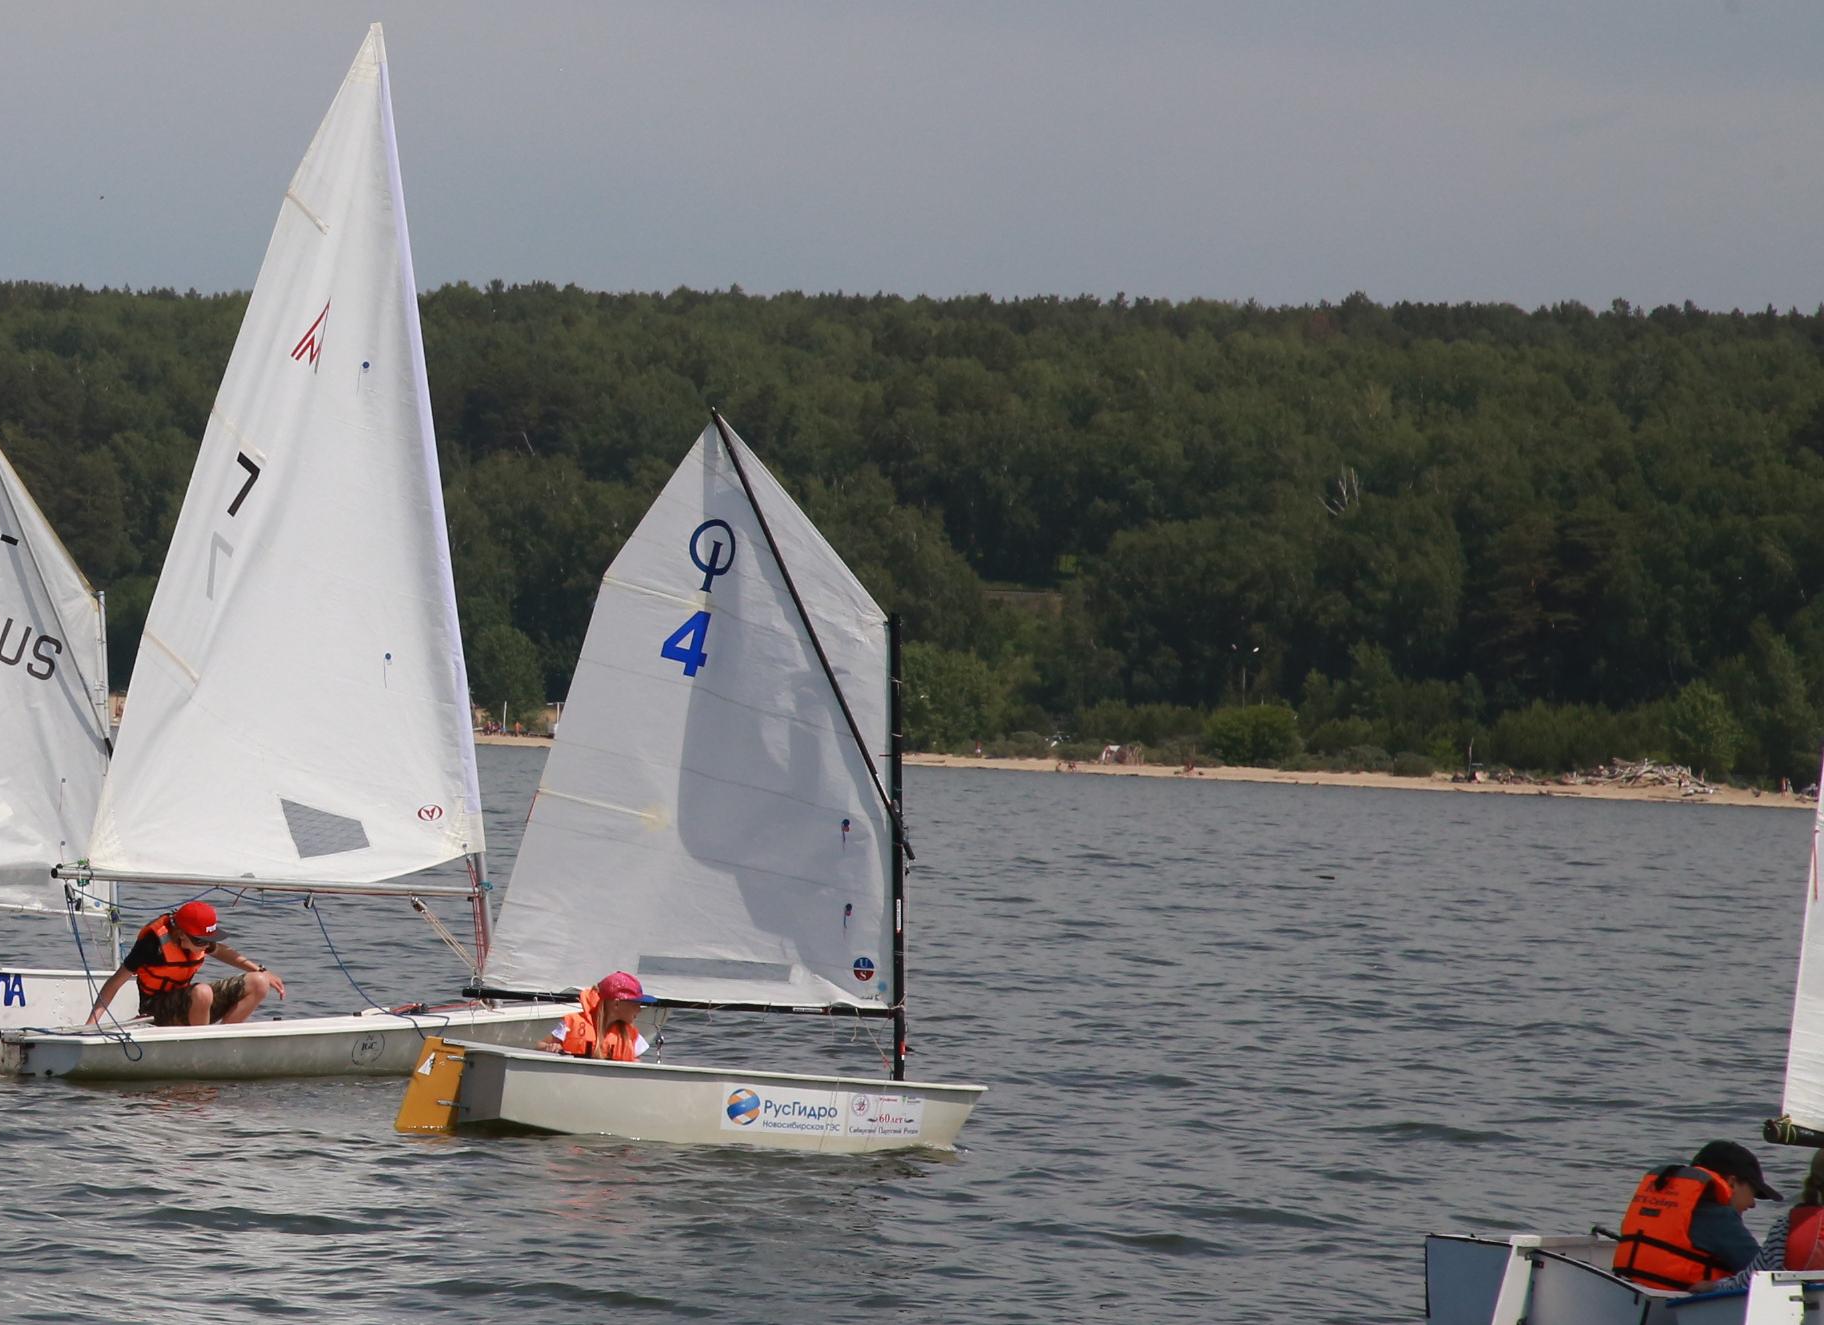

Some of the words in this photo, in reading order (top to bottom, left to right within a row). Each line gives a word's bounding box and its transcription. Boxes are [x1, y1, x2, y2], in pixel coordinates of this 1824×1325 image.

[227, 451, 261, 517] 7
[660, 611, 712, 677] 4
[762, 1120, 824, 1131] Новосибирская
[763, 1099, 838, 1120] РусГидро
